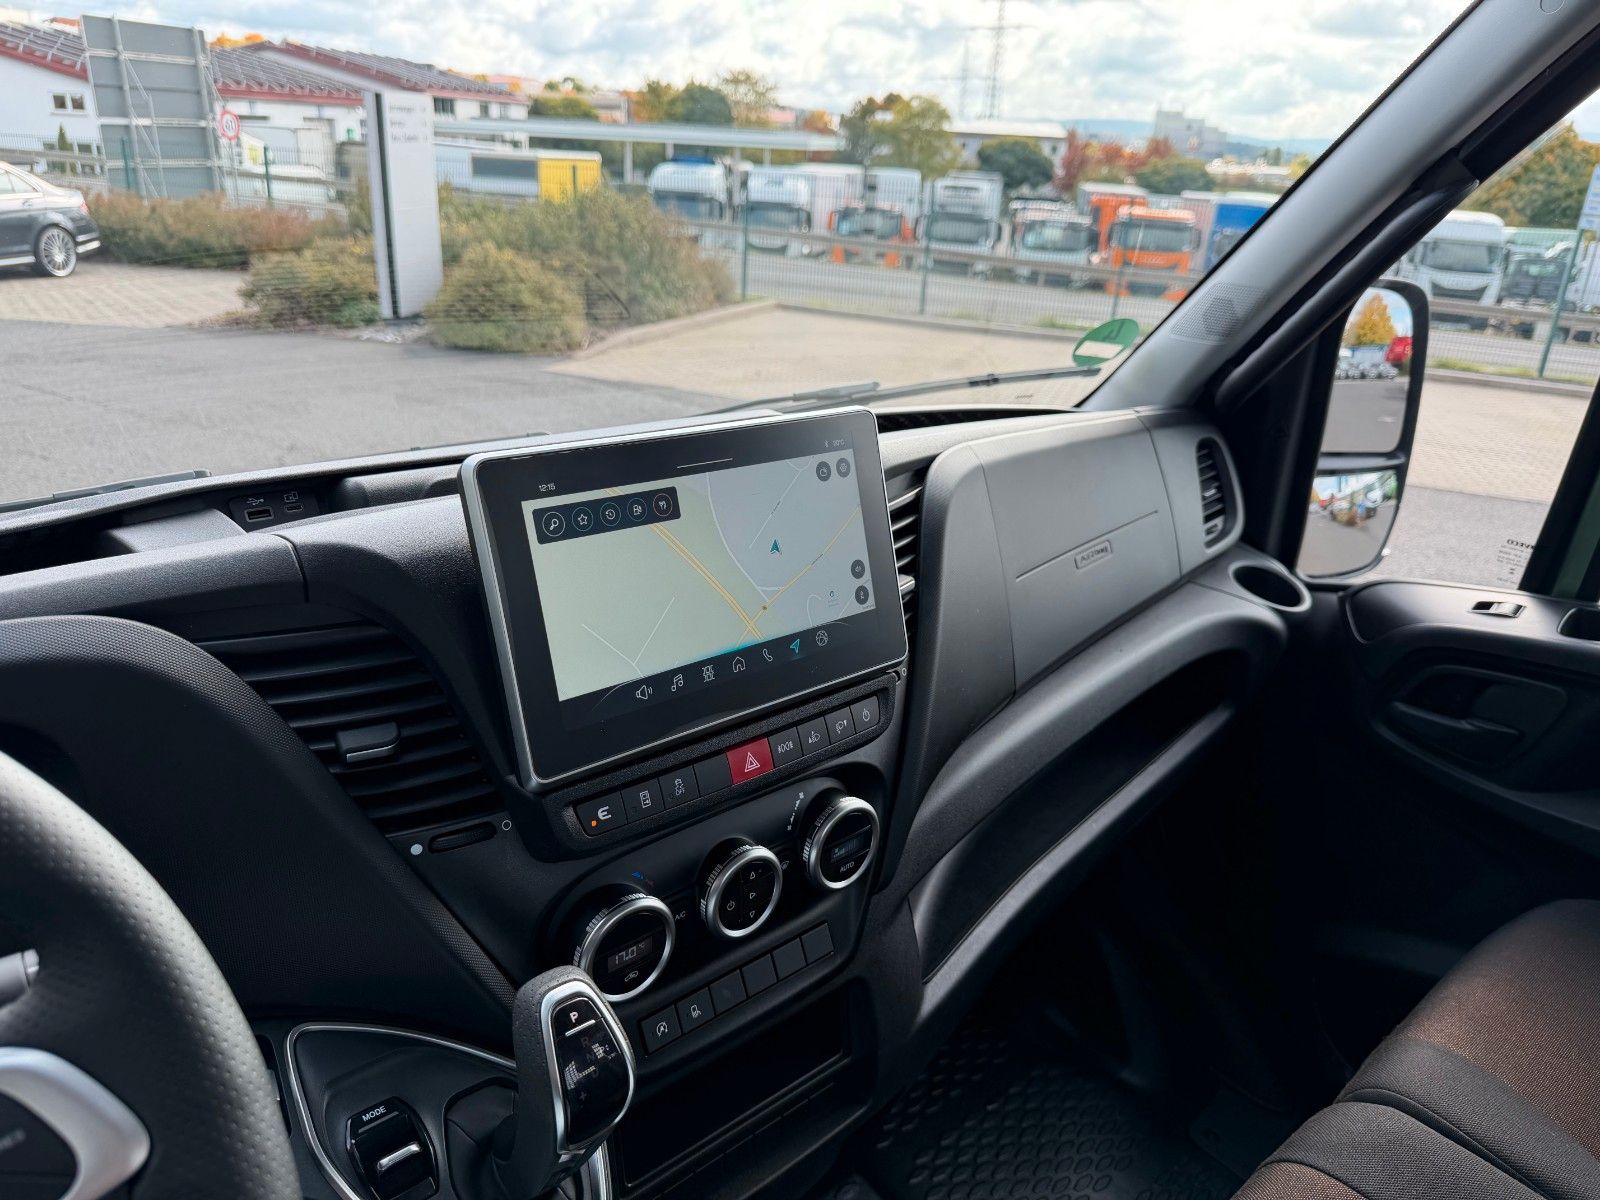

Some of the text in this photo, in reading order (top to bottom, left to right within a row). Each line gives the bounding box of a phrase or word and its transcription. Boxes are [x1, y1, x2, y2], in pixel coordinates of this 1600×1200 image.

[840, 861, 855, 872] AUTO
[615, 945, 637, 965] 17.0
[569, 1011, 579, 1023] P
[362, 1105, 386, 1122] MODE
